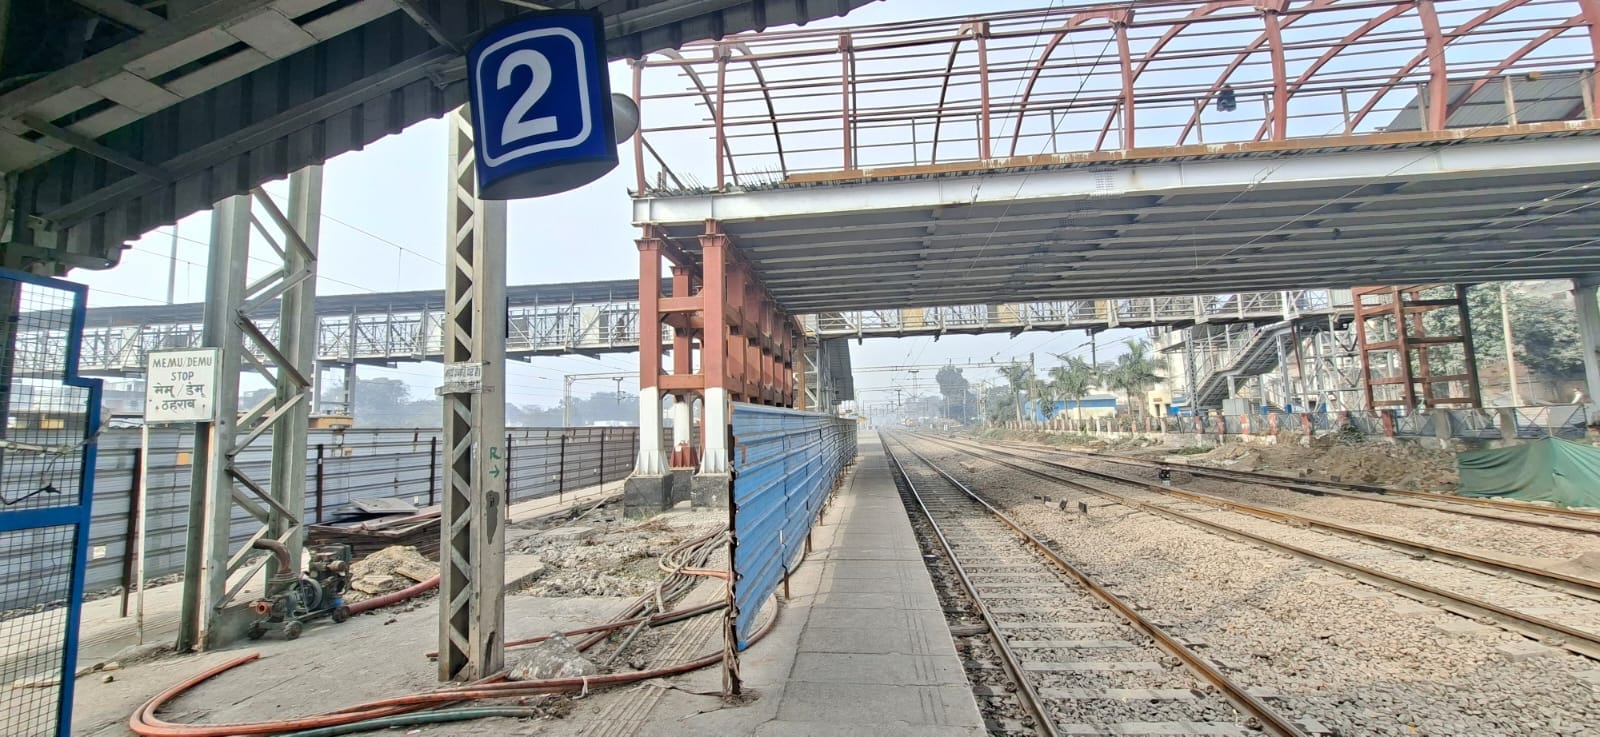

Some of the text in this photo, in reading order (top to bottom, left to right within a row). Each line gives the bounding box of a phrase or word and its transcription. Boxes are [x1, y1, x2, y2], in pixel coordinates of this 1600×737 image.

[497, 49, 558, 146] 2
[171, 372, 194, 381] STOP
[490, 446, 501, 459] R
